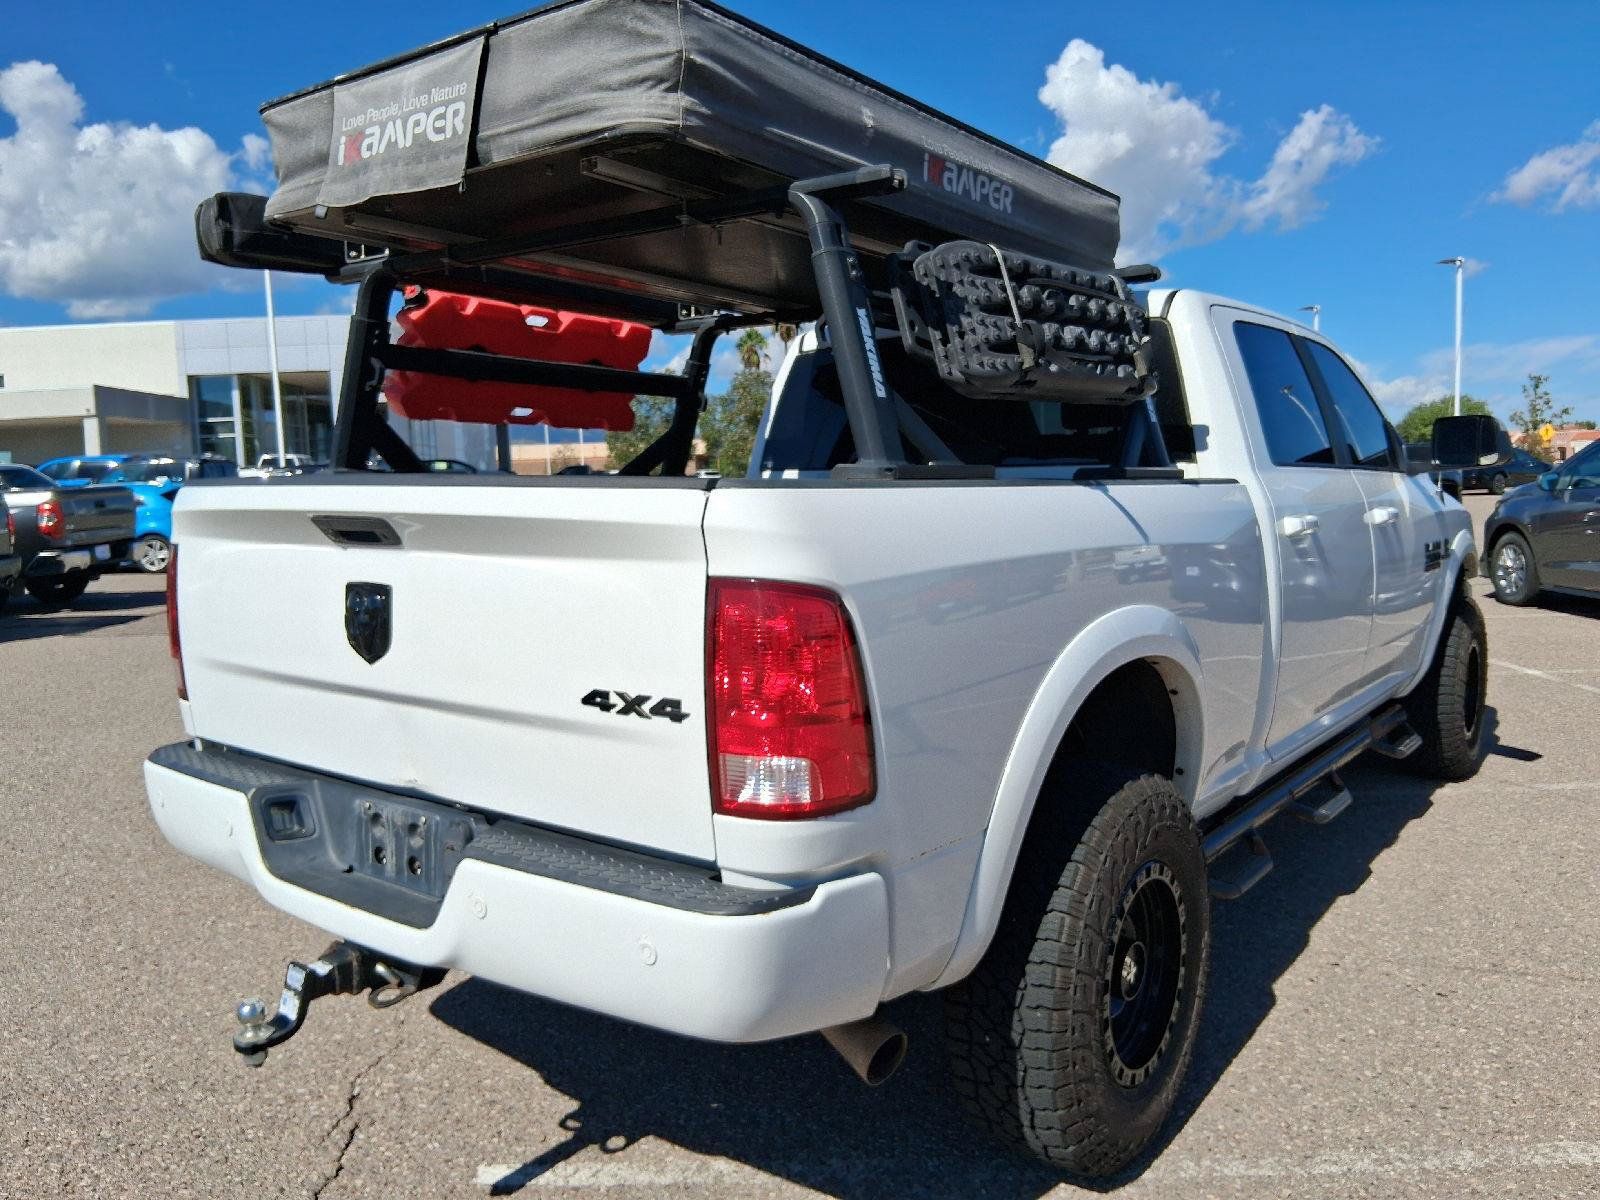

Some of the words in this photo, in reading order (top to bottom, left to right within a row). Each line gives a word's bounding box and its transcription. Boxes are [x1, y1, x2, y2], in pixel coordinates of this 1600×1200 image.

[342, 114, 365, 131] Love
[366, 103, 401, 124] People,
[403, 94, 428, 112] Love
[431, 82, 467, 103] Nature
